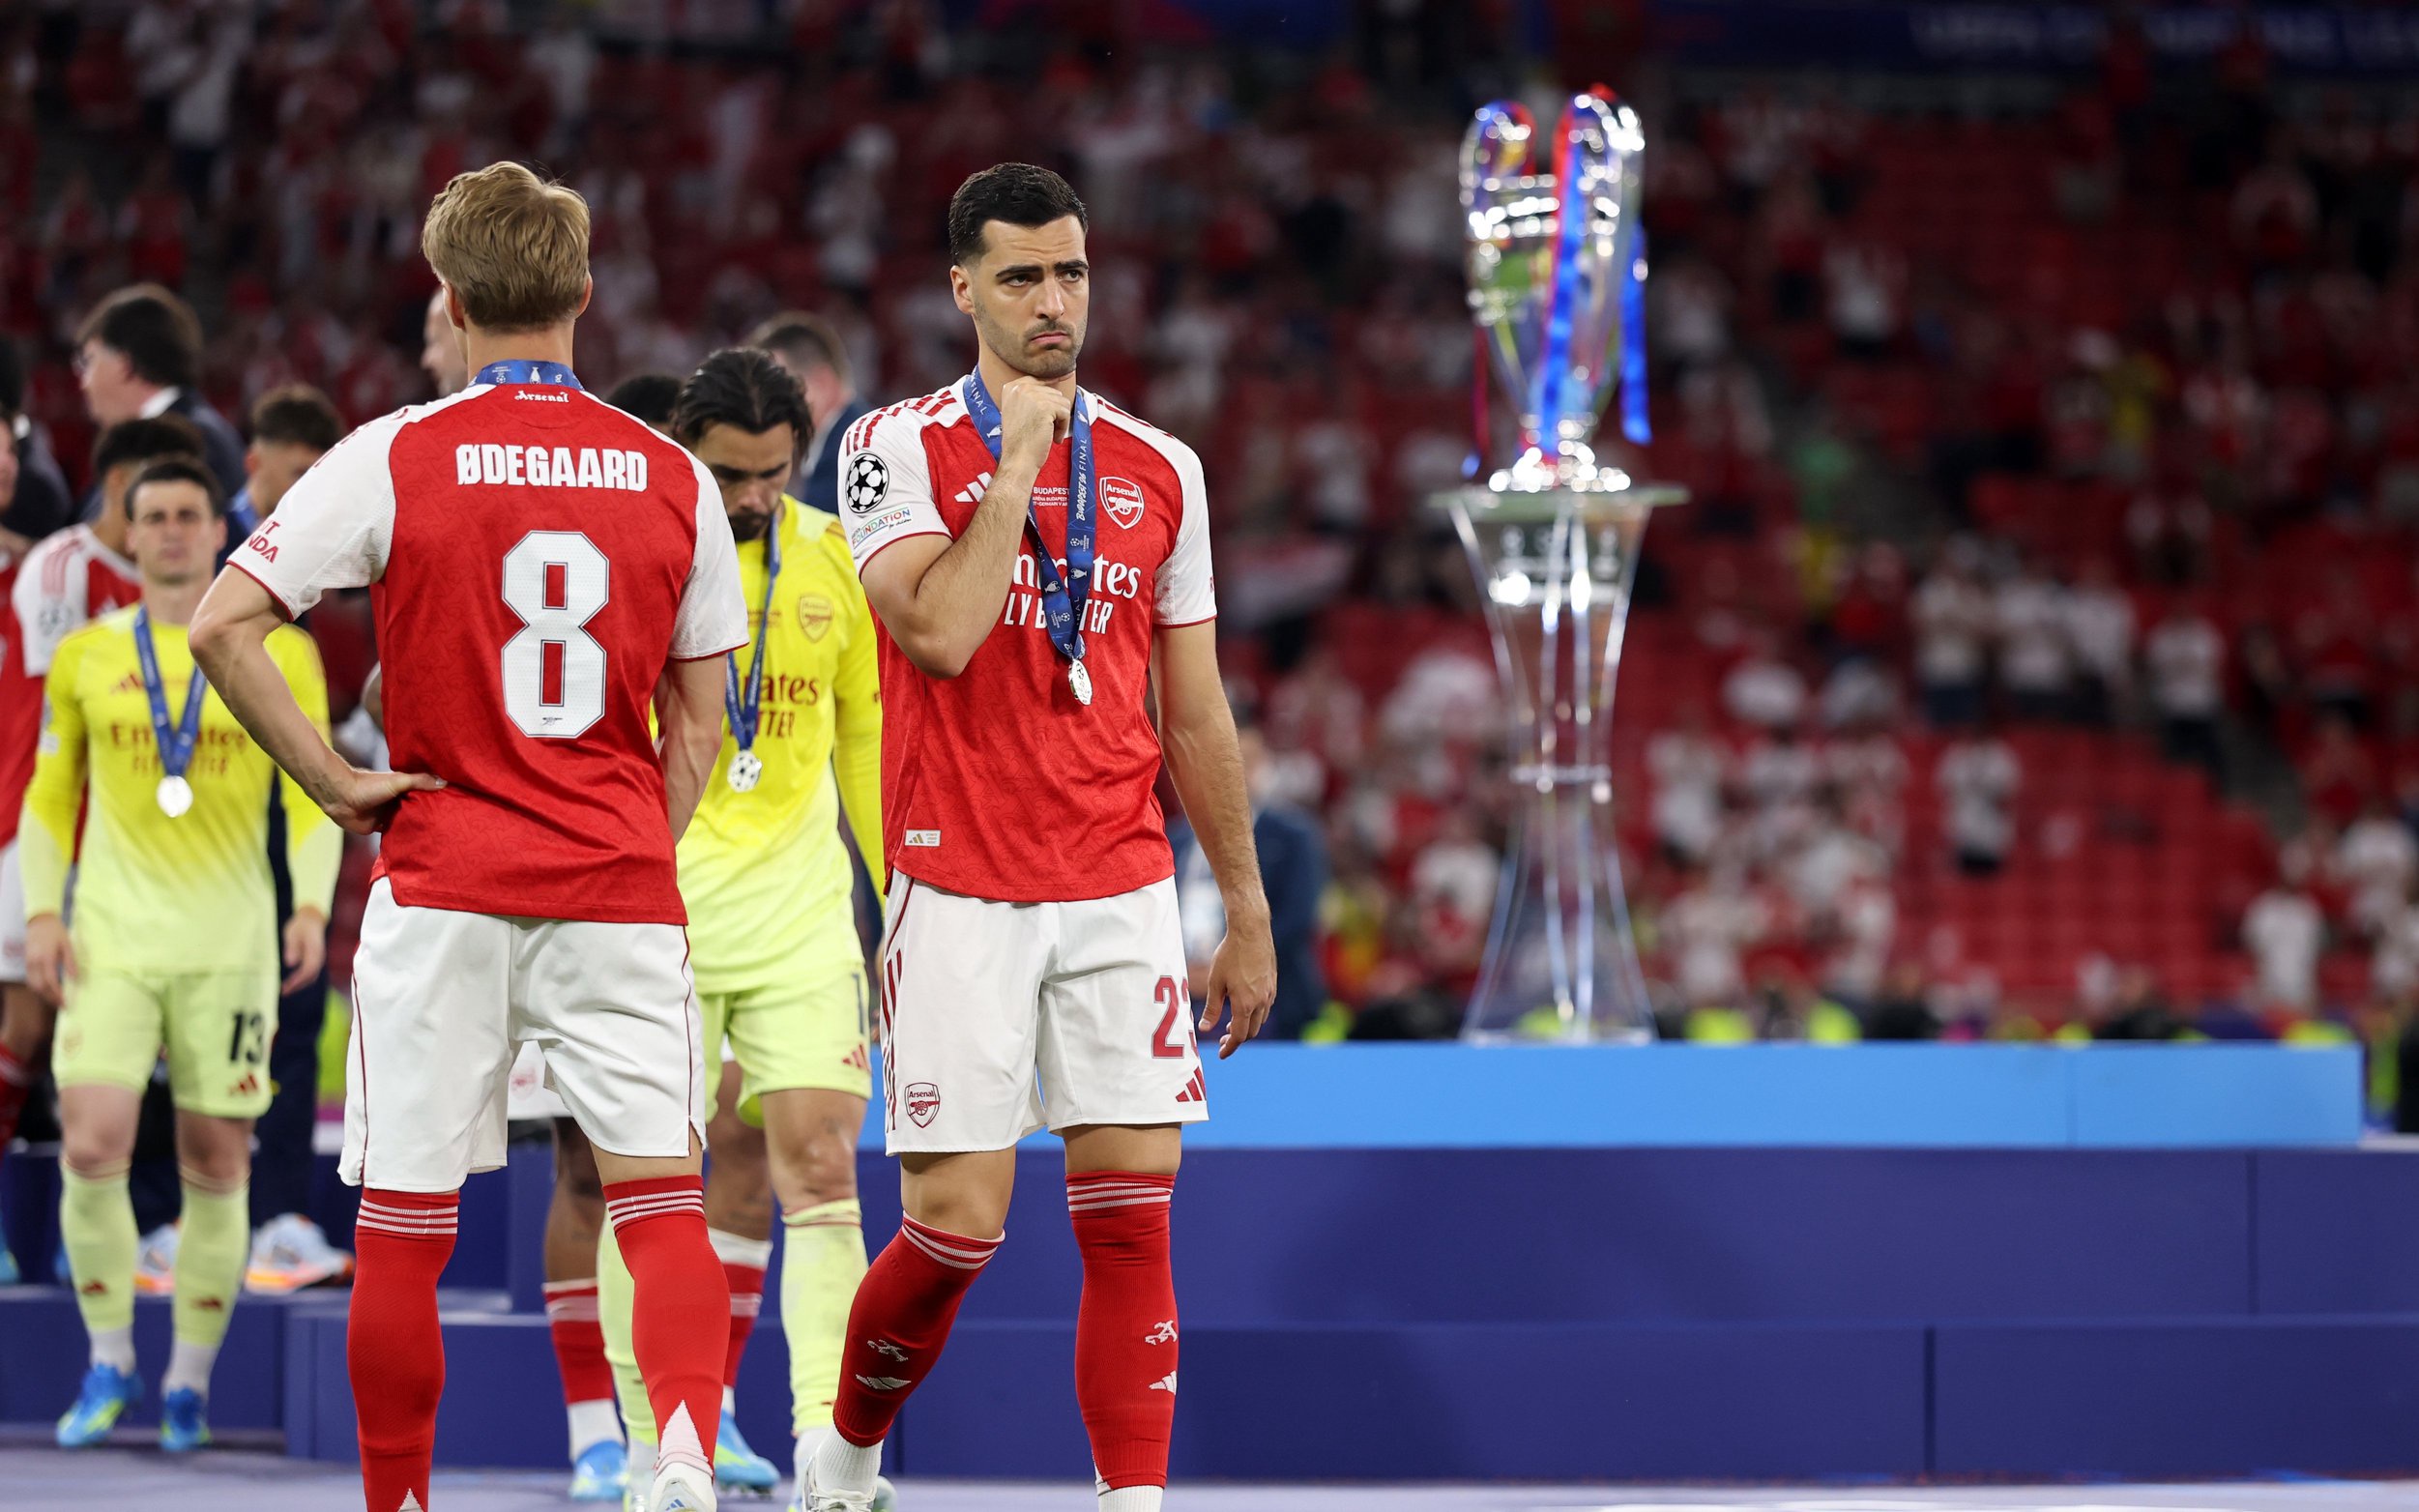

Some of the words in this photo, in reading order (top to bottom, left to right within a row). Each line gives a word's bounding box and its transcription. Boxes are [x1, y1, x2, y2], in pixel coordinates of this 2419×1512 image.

[514, 390, 569, 403] Arsenal
[970, 381, 987, 416] FINAL
[455, 443, 648, 492] ØDEGAARD
[1078, 438, 1088, 472] FINAL
[1075, 482, 1088, 521] BUDAPEST
[1106, 483, 1139, 498] Arsenal
[852, 509, 911, 547] FOUNDATION
[248, 535, 279, 564] NDA
[1004, 592, 1033, 626] LY
[502, 530, 610, 739] 8
[230, 1011, 265, 1064] 13
